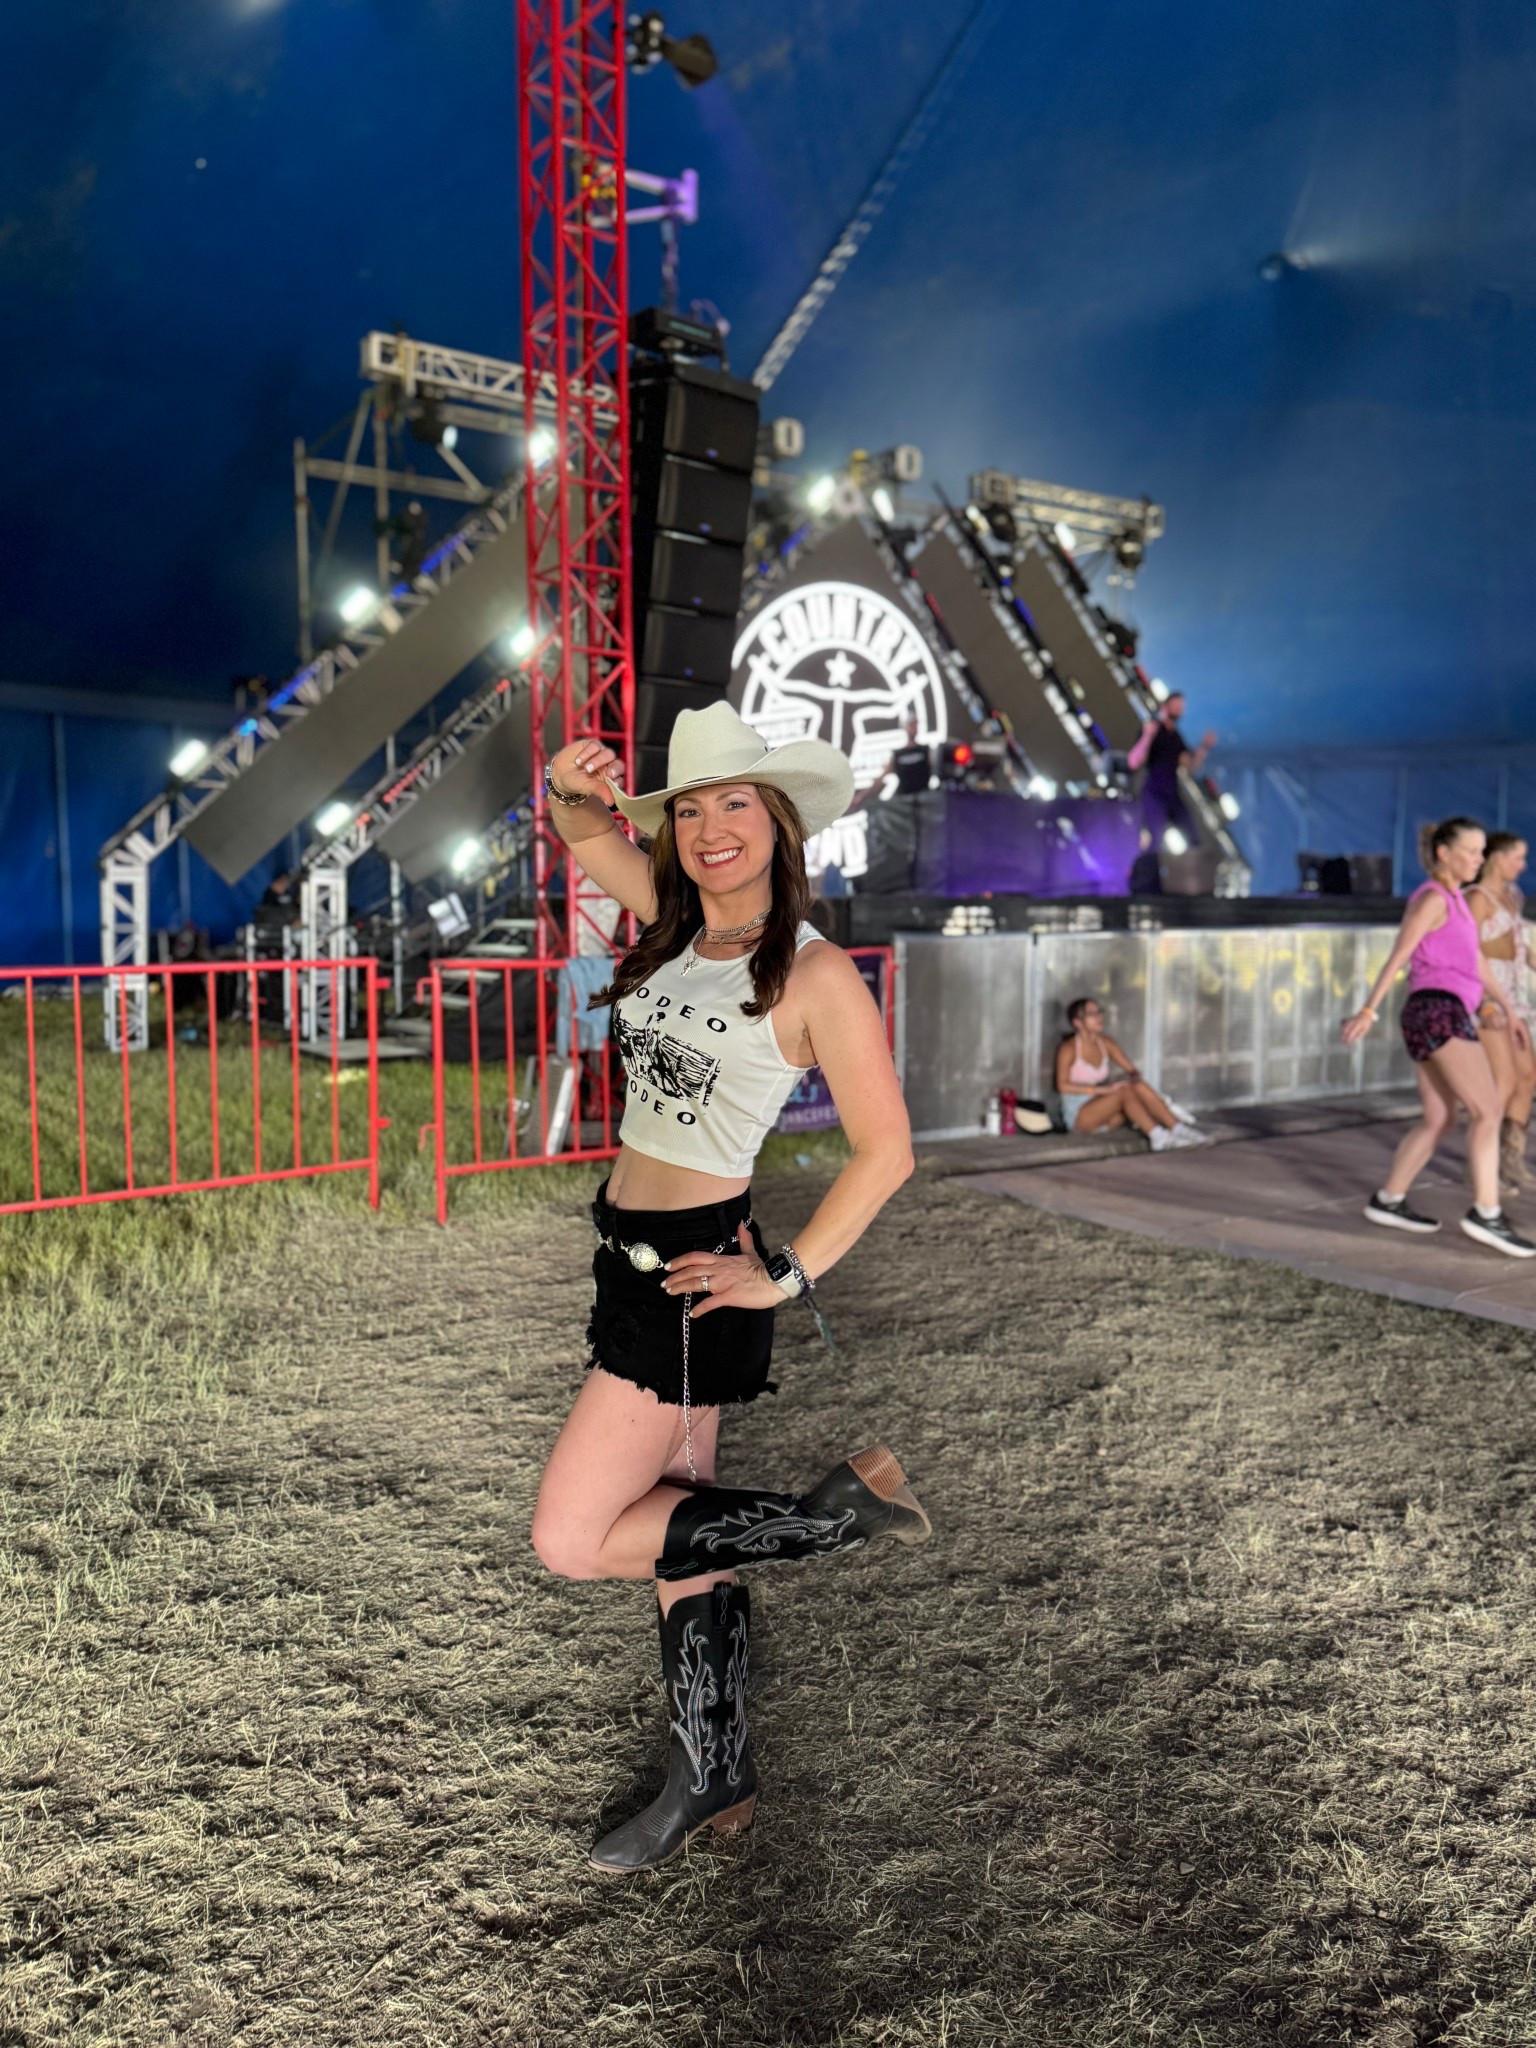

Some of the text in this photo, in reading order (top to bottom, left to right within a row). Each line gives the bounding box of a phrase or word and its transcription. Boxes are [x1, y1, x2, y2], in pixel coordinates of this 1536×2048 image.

[759, 593, 922, 676] COUNTRY
[636, 987, 727, 1033] ODEO
[629, 1080, 696, 1125] ODEO
